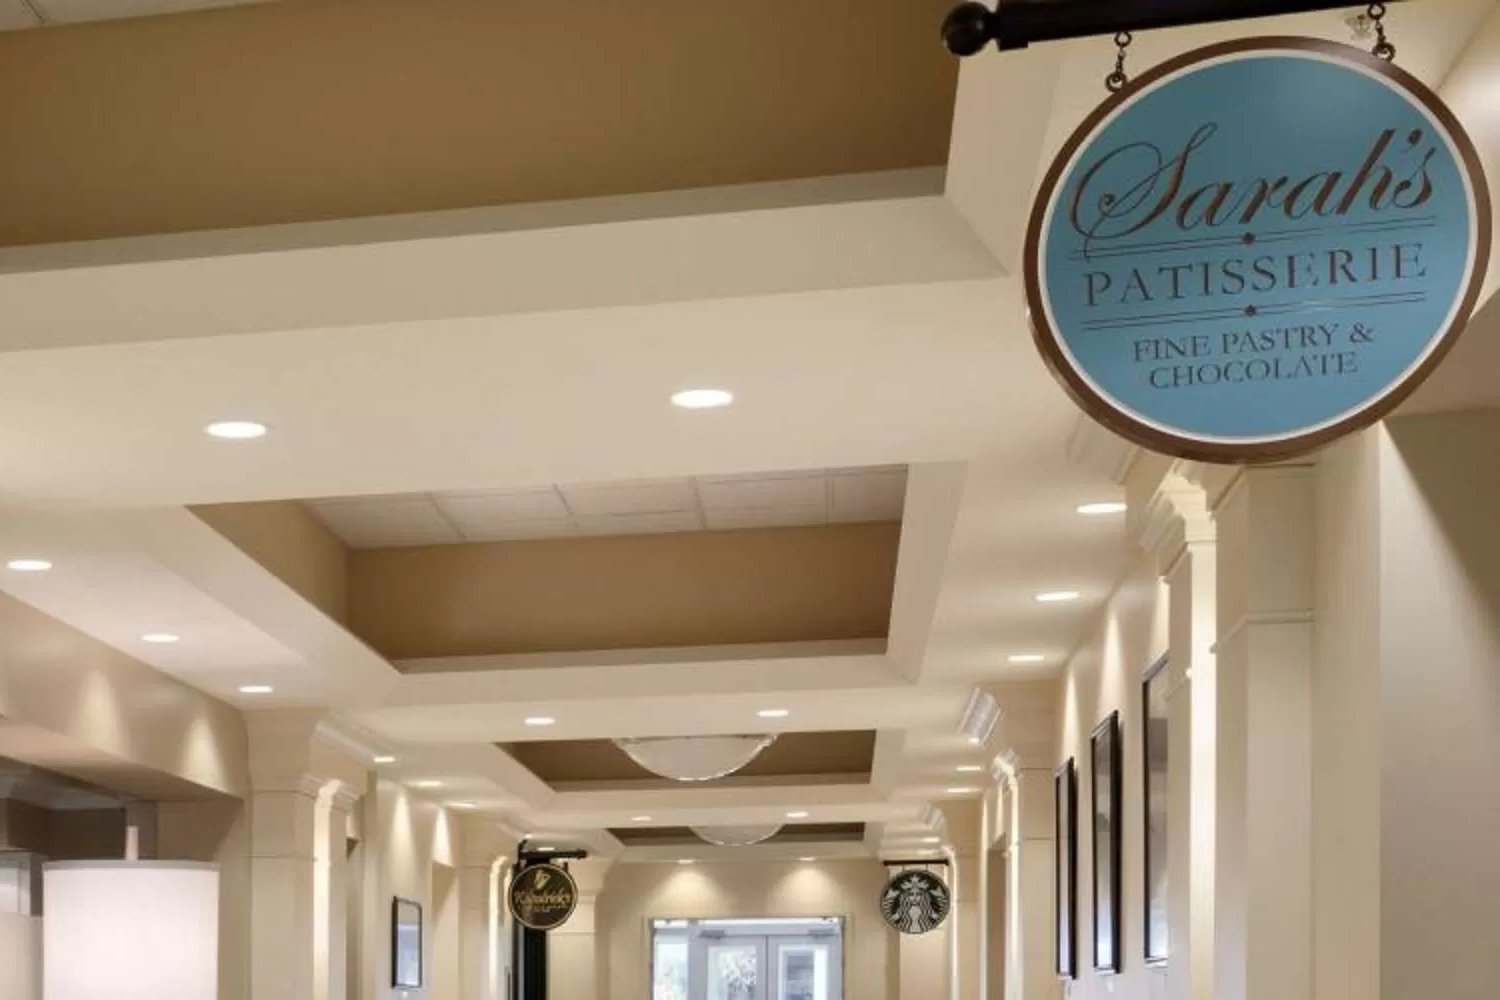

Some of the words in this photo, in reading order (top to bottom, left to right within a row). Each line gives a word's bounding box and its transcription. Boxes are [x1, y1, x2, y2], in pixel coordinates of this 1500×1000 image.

[1069, 121, 1437, 263] Sarah's
[1083, 242, 1426, 308] PATISSERIE
[1133, 332, 1211, 363] FINE
[1222, 322, 1341, 356] PASTRY
[1349, 321, 1375, 344] &
[1149, 351, 1359, 391] CHOCOLATE
